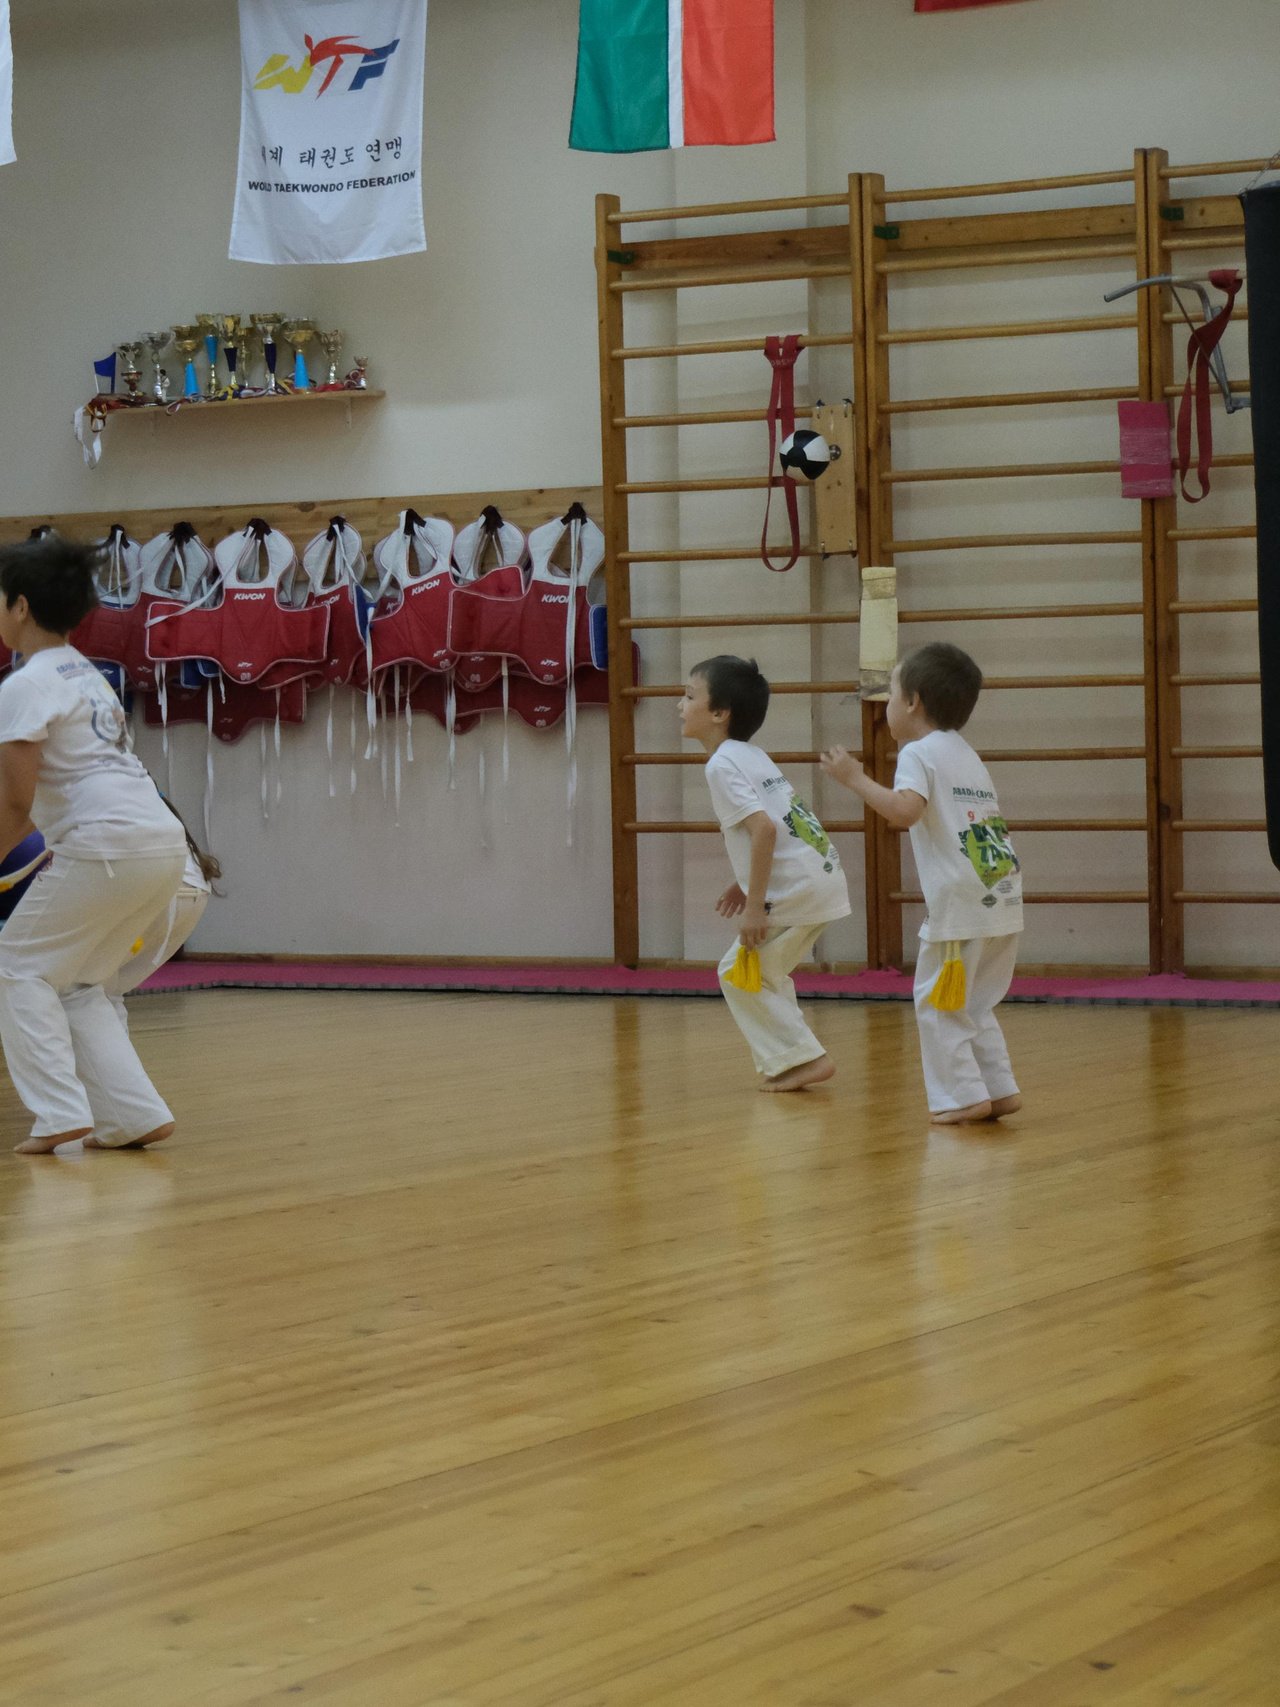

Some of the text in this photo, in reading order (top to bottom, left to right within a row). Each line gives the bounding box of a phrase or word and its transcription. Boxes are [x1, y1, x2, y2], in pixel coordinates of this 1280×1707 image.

[299, 146, 354, 169] 태권도
[365, 136, 402, 163] 연맹
[274, 182, 343, 193] TAEKWONDO
[346, 170, 416, 190] FEDERATION
[233, 592, 266, 600] KWON
[411, 578, 440, 596] KWON
